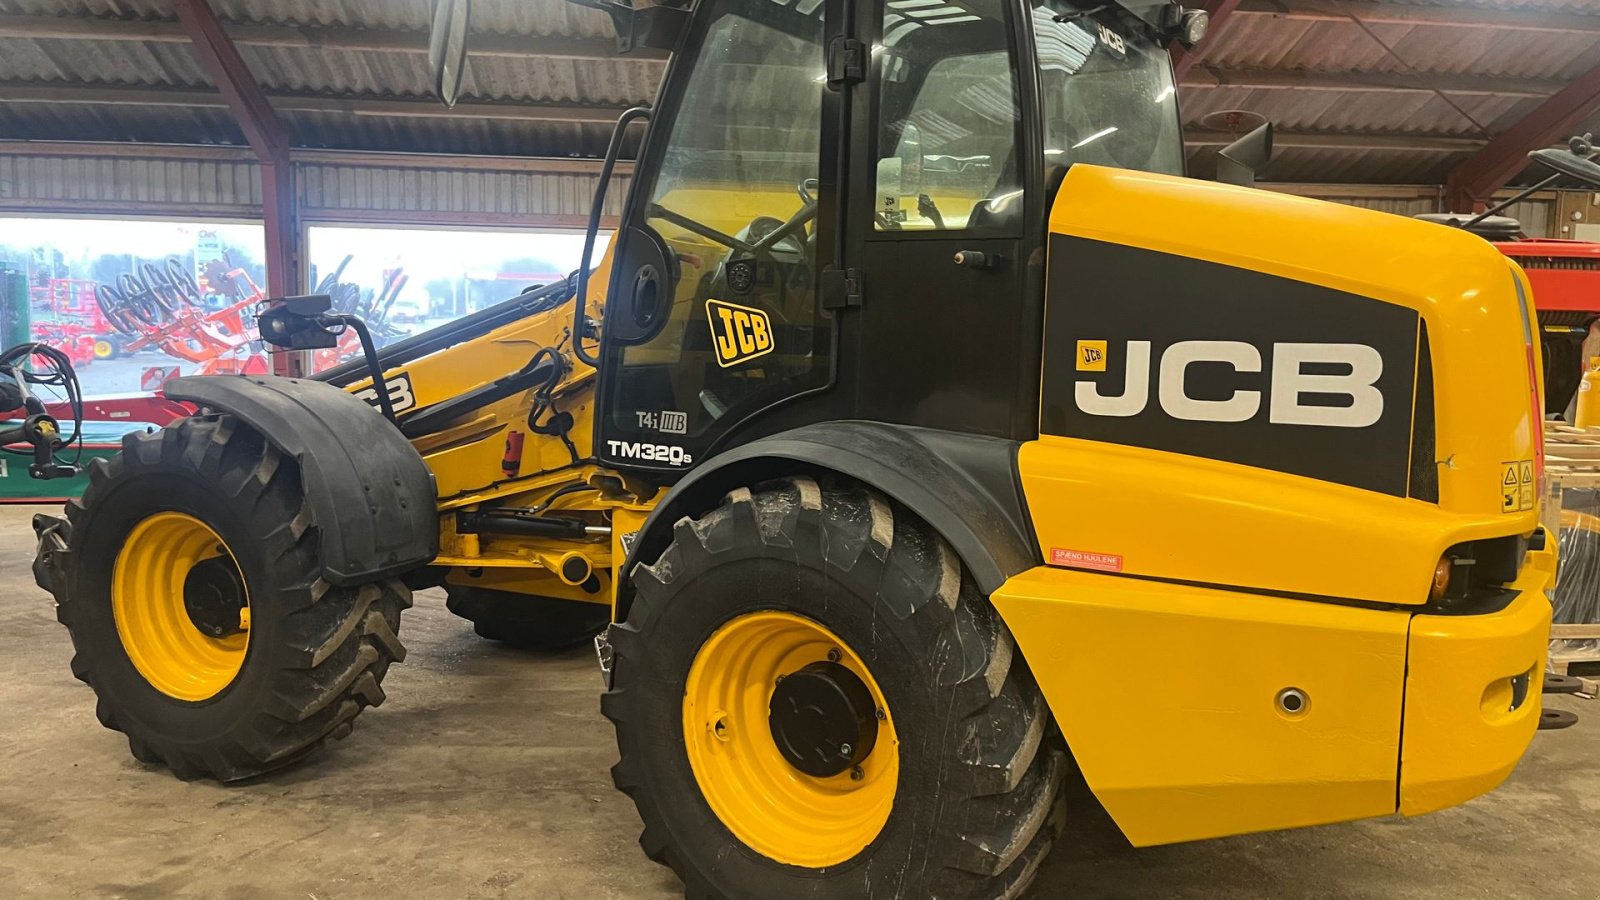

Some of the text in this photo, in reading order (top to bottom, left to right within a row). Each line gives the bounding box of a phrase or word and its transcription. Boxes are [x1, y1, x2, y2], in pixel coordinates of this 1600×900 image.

[1097, 22, 1126, 55] JCB
[717, 307, 769, 360] JCB
[1084, 347, 1102, 363] JCB
[1075, 340, 1384, 428] JCB
[636, 411, 659, 429] T4i
